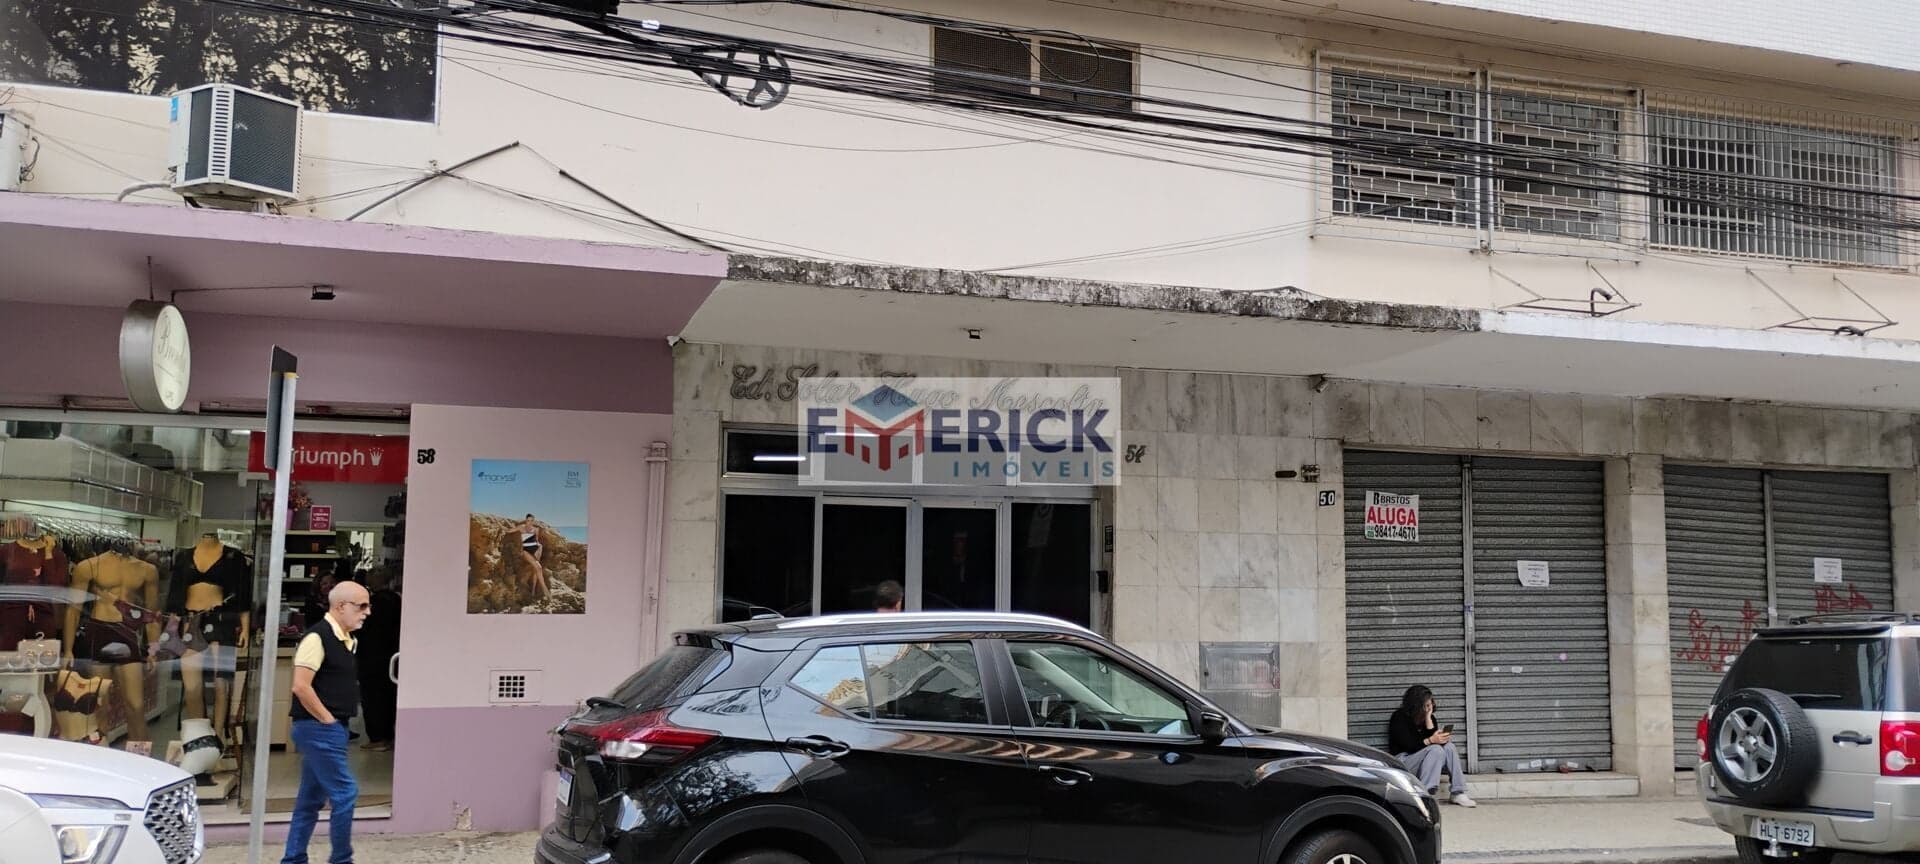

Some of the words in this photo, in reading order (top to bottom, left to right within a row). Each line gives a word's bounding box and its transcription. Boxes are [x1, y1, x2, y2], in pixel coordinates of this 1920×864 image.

[290, 446, 365, 470] riumph
[417, 448, 436, 464] 58
[1125, 444, 1147, 463] 54
[1319, 492, 1335, 505] 50
[1380, 496, 1410, 504] BASTOS
[1366, 506, 1417, 526] ALUGA
[1374, 525, 1416, 540] 98417-4670
